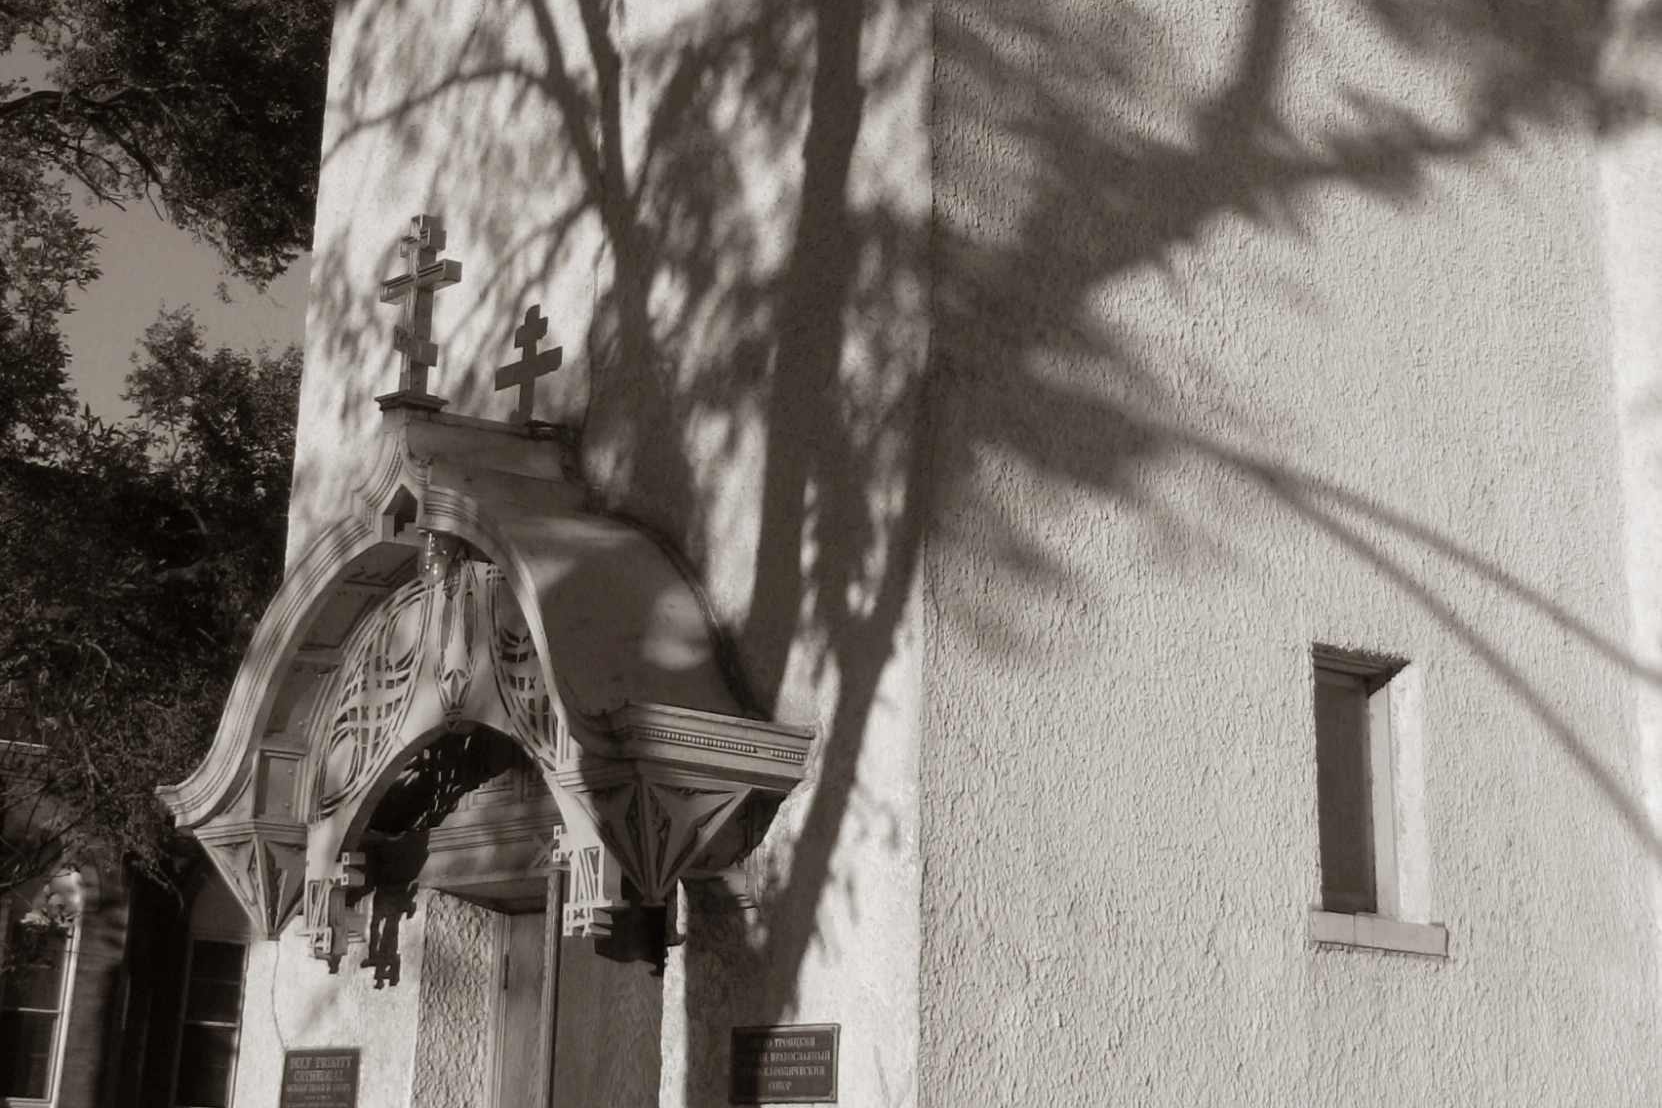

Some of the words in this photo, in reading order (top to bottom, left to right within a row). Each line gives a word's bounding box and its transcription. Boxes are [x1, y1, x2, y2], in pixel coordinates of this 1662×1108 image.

[290, 1057, 313, 1069] HOLY
[315, 1056, 353, 1068] TRINITY
[294, 1070, 345, 1082] CATHEDRAL
